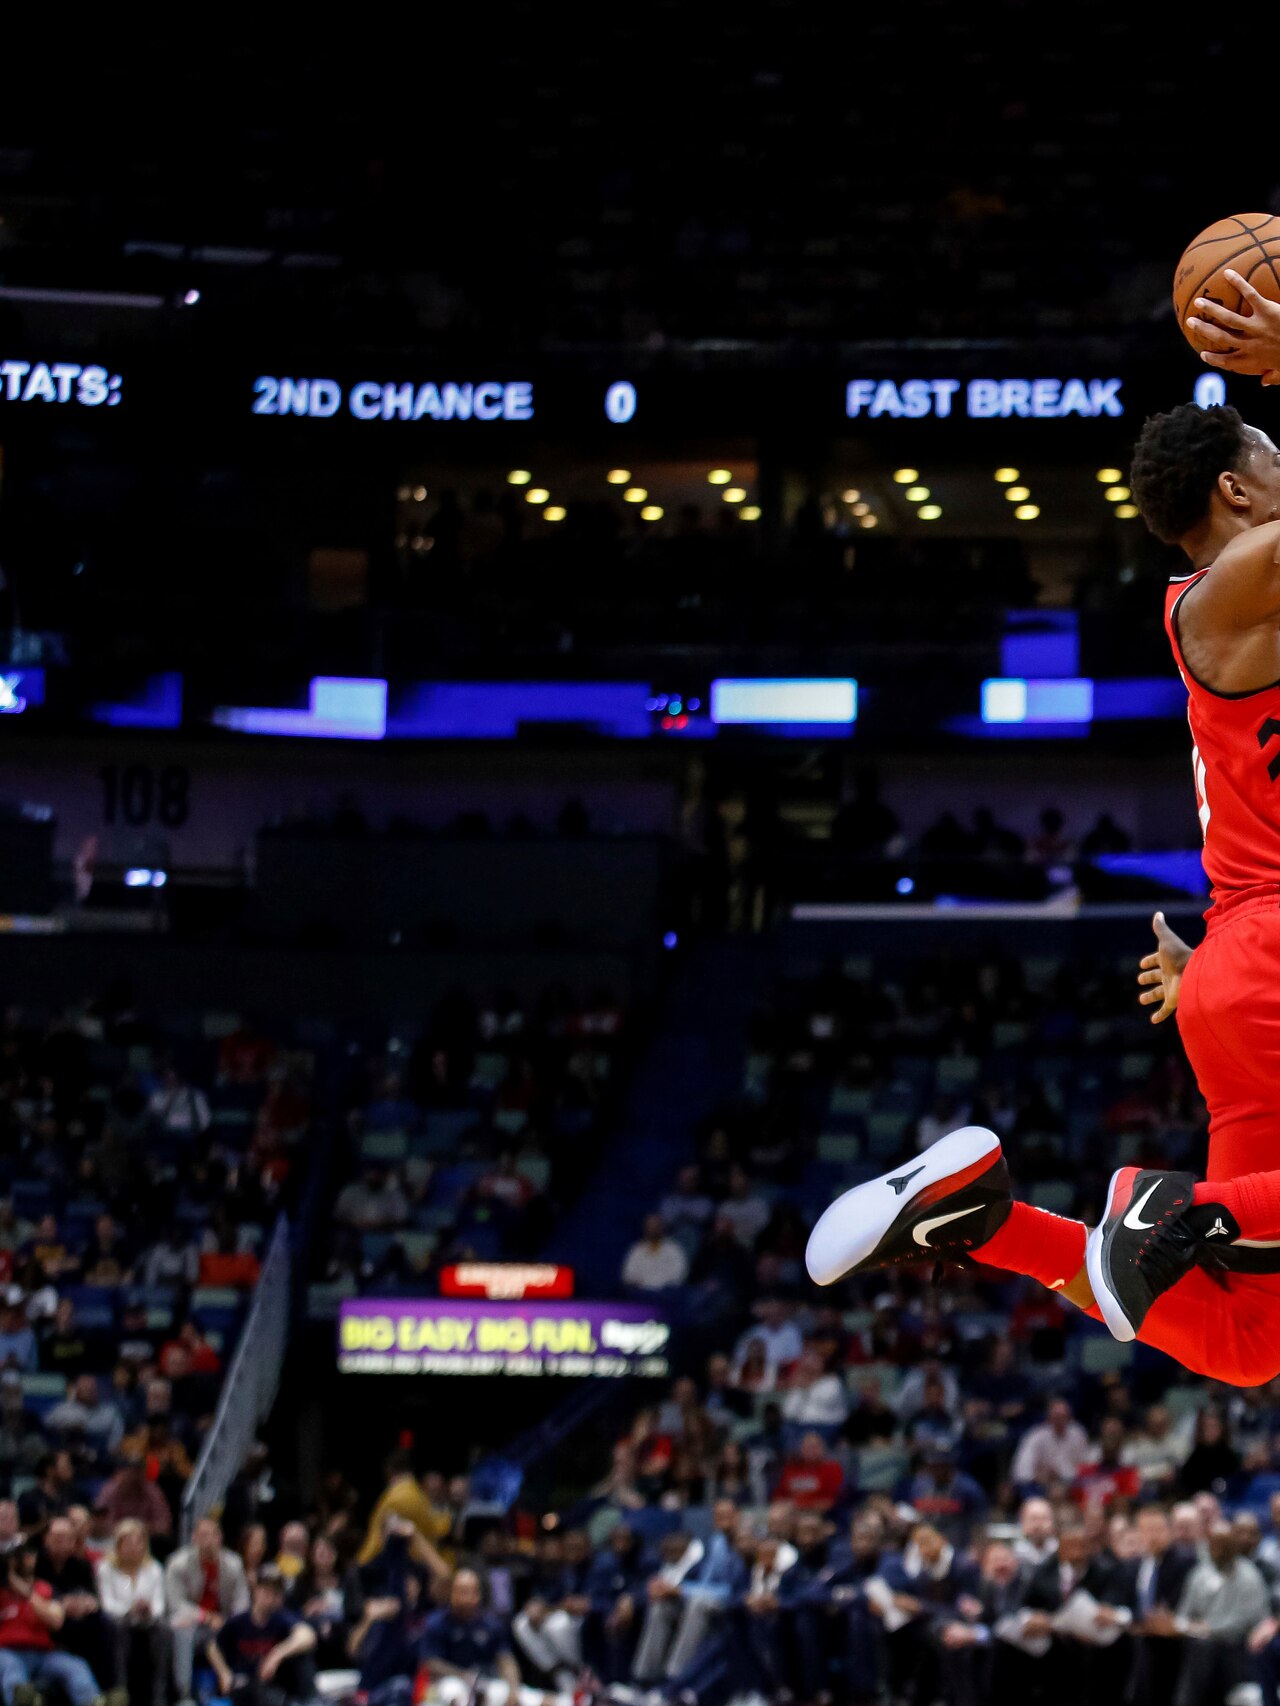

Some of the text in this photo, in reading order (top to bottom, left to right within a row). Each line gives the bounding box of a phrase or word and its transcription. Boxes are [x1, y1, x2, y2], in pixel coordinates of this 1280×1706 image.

[0, 360, 122, 406] TATS:
[252, 376, 534, 421] 2ND CHANCE
[605, 381, 637, 423] 0
[846, 378, 1125, 418] FAST BREAK
[99, 763, 190, 828] 108
[341, 1316, 395, 1351] BIG
[476, 1317, 529, 1353] BIG
